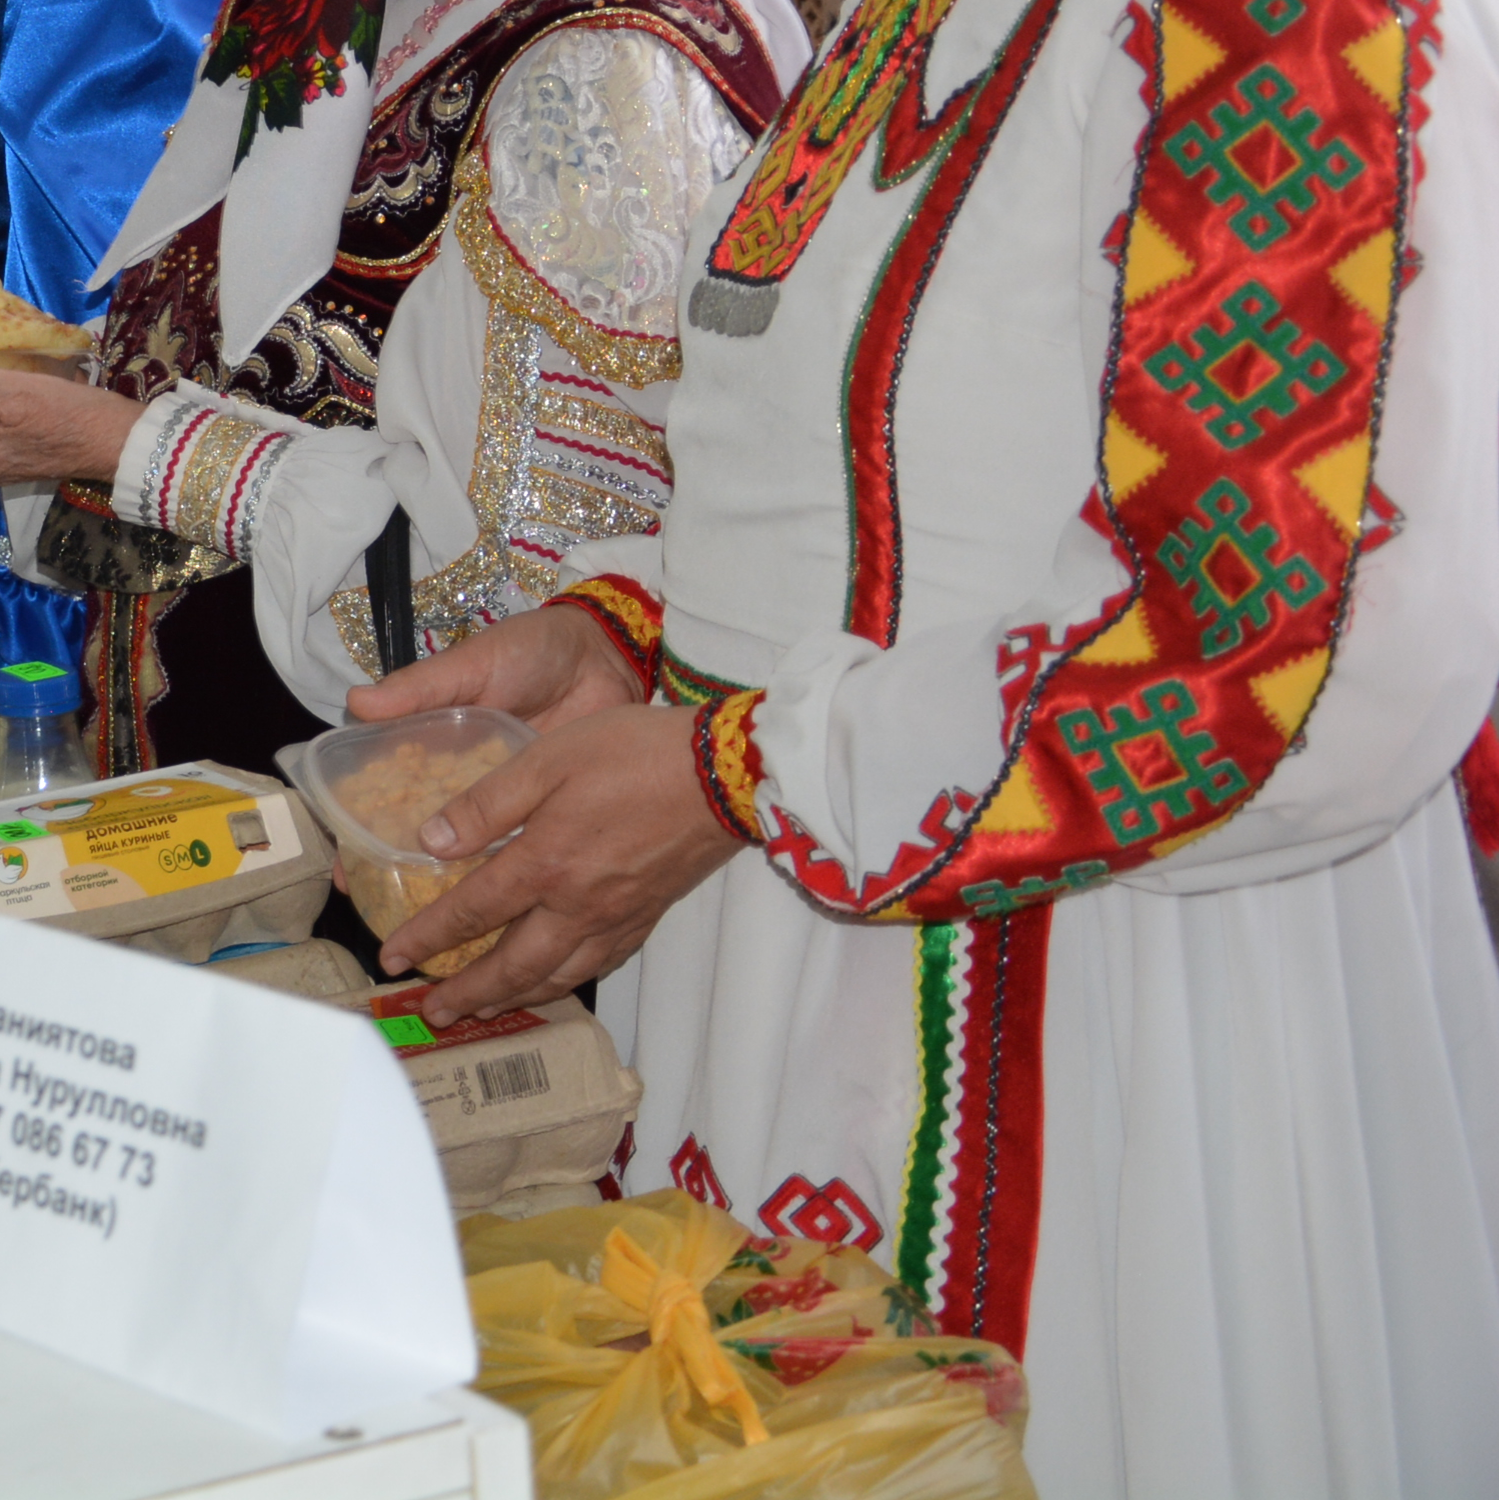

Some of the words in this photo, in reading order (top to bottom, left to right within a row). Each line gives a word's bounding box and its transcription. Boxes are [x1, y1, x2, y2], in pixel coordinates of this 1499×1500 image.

[89, 841, 120, 854] ЯЙЦА
[120, 830, 171, 848] КУРИНЫЕ
[64, 870, 109, 885] отборной
[70, 878, 119, 892] категории
[5, 894, 33, 906] птица
[9, 1056, 208, 1150] Нурулловна
[10, 1111, 64, 1159] 086
[71, 1131, 110, 1171] 67
[118, 1144, 157, 1188] 73
